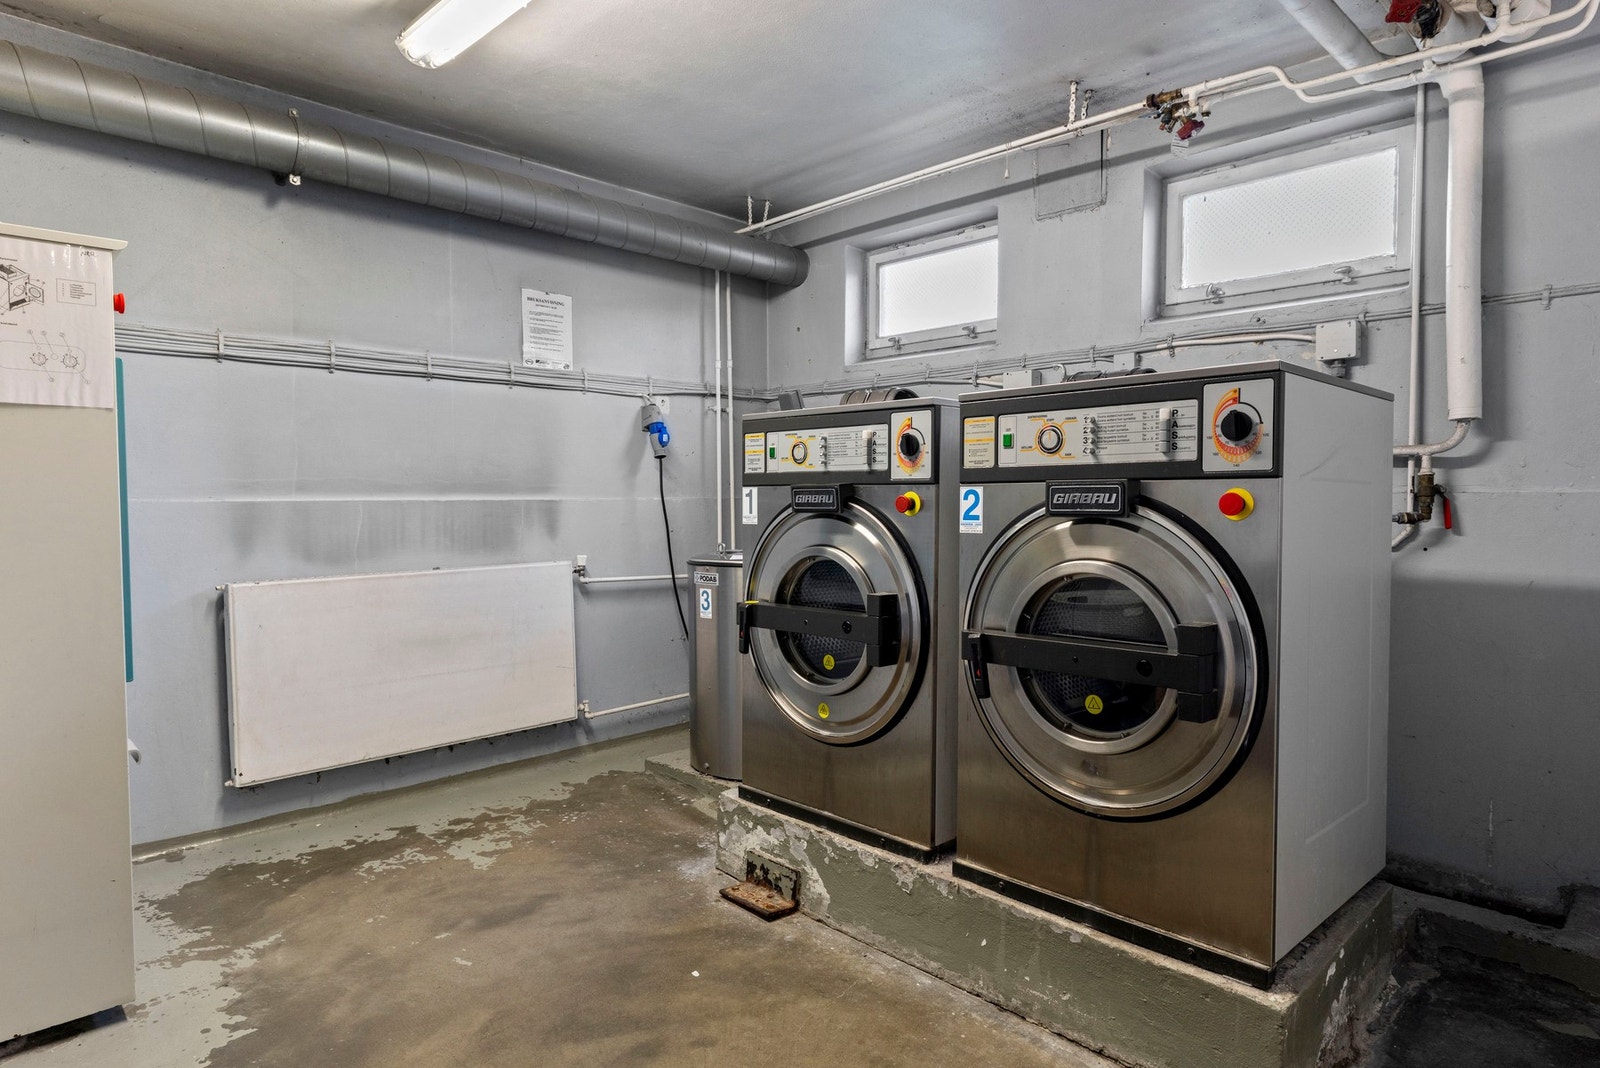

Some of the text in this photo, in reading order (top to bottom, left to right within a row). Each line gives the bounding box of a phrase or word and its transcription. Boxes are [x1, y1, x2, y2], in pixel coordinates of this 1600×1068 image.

[745, 488, 753, 515] 1
[795, 493, 835, 504] GIRBAU
[962, 488, 981, 521] 2
[1052, 492, 1118, 504] GIRBAU
[699, 575, 718, 583] PODAB
[701, 589, 711, 611] 3
